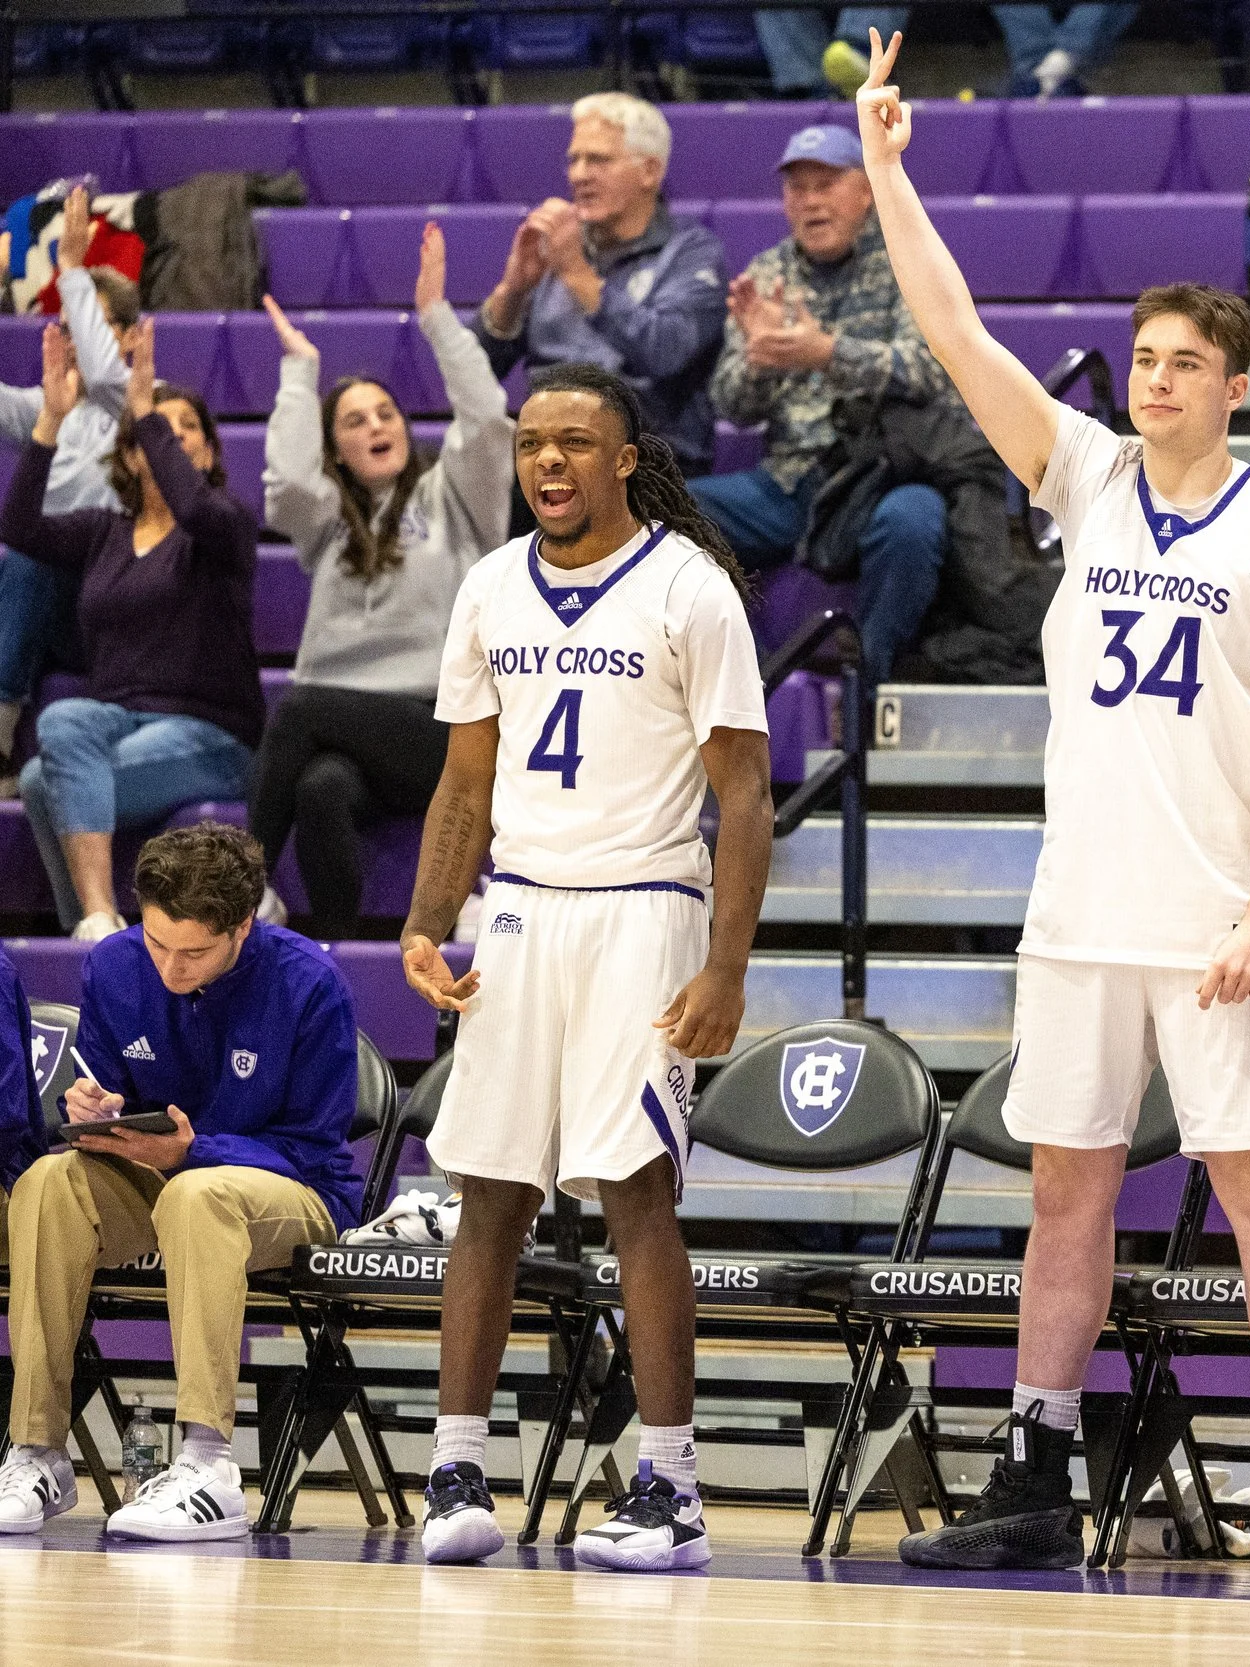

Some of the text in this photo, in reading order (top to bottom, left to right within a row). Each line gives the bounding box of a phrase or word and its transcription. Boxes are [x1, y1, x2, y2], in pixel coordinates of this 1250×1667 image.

[558, 603, 583, 611] adidas
[489, 646, 645, 679] HOLY CROSS
[1090, 609, 1204, 717] 34
[882, 702, 895, 738] C
[526, 689, 584, 790] 4
[122, 1048, 156, 1061] adidas
[870, 1271, 1021, 1297] CRUSADER
[1151, 1277, 1247, 1303] CRUSA
